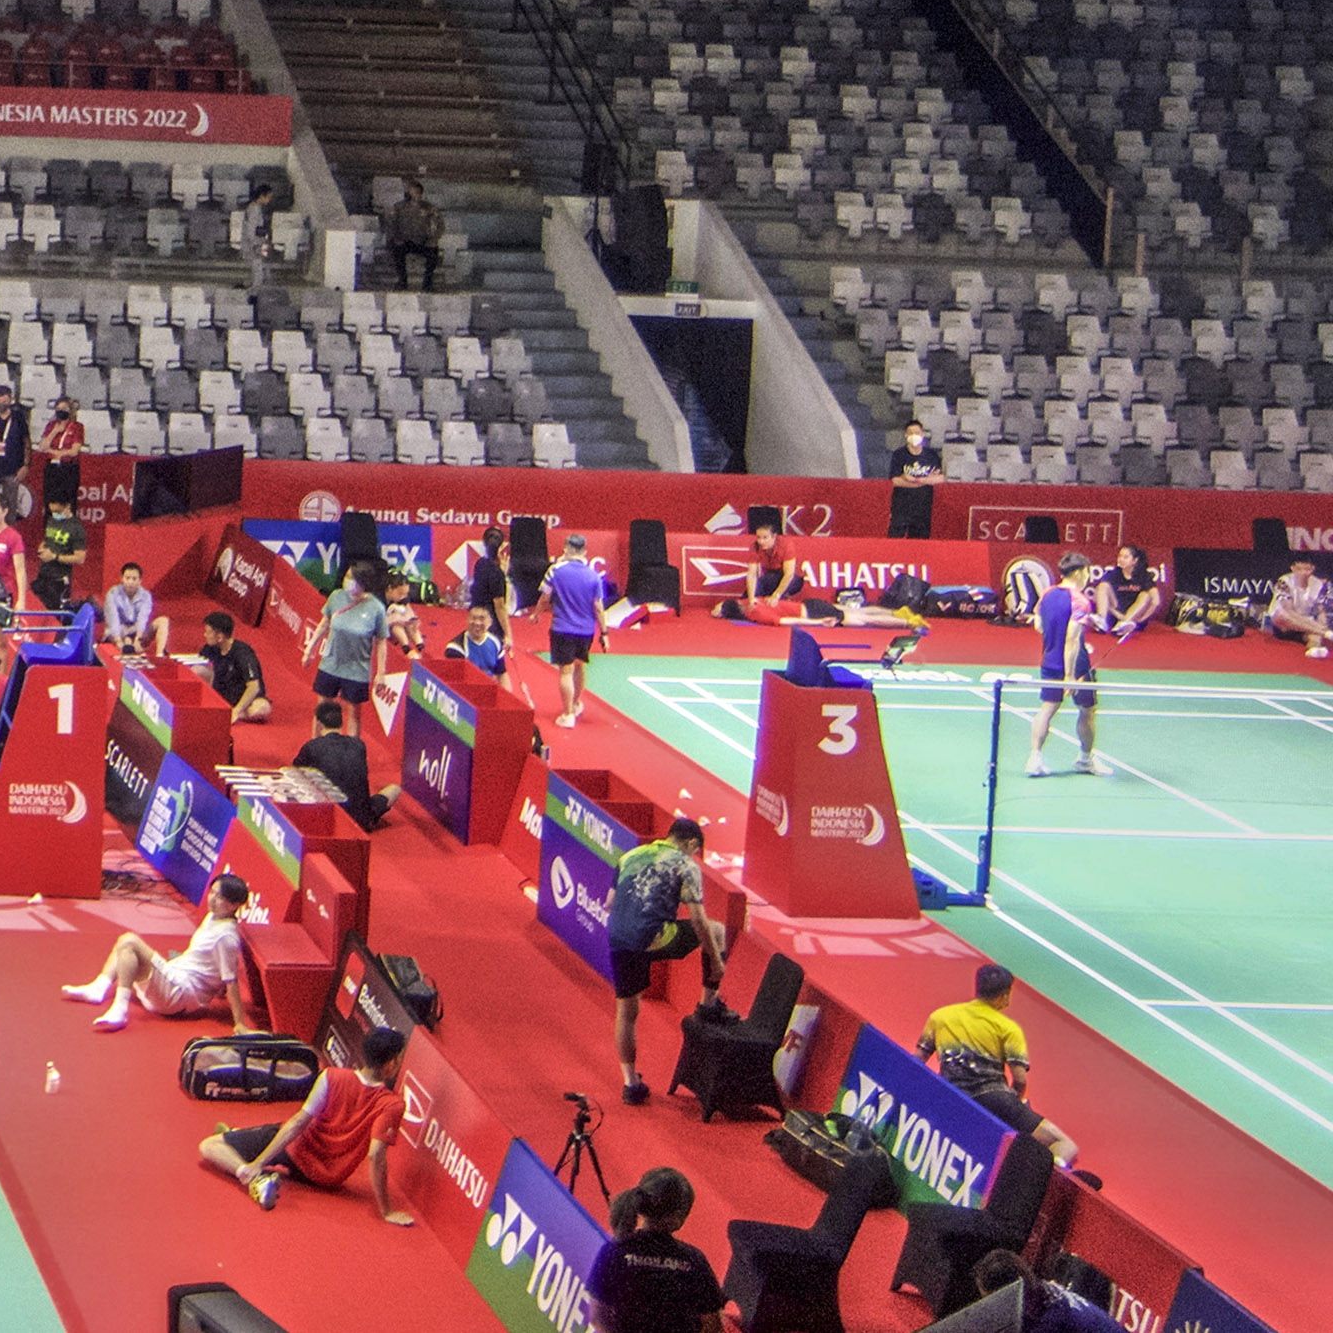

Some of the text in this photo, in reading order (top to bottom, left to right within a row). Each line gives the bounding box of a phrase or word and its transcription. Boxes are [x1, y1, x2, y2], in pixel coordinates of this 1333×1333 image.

[50, 104, 137, 127] MASTERS
[143, 109, 187, 128] 2022
[416, 508, 490, 525] Sedayu
[1203, 576, 1274, 594] ISMAYA
[48, 684, 74, 735] 1
[818, 704, 859, 755] 3
[104, 738, 149, 799] SCARLETT
[8, 783, 68, 796] DAIHATSU
[8, 794, 68, 806] INDONESIA
[810, 805, 866, 818] DAIHATSU
[810, 817, 866, 829] INDONESIA
[424, 1119, 488, 1209] DAIHATSU
[893, 1103, 985, 1208] YONEX
[526, 1234, 597, 1333] YONE
